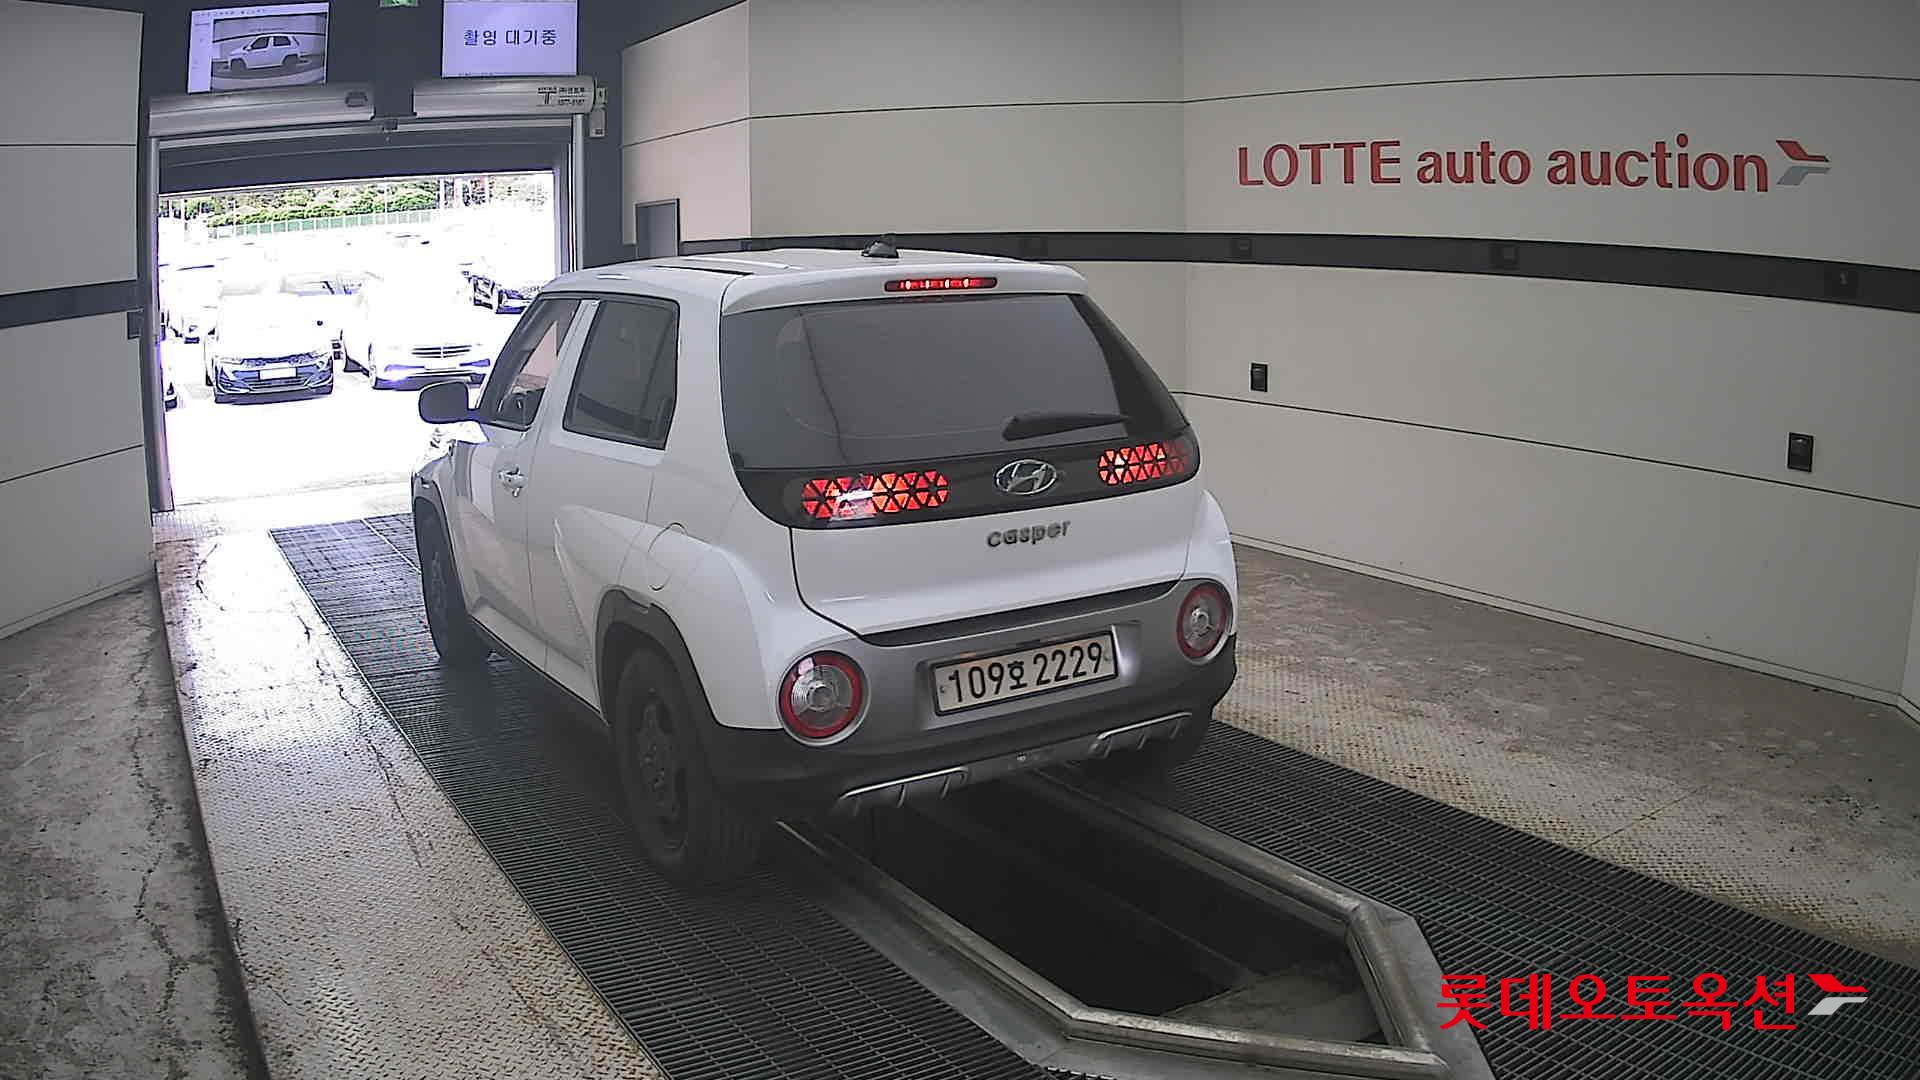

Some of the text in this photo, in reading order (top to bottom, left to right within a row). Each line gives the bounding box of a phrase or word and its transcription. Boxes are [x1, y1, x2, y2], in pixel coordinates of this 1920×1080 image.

[505, 28, 557, 46] 대기중
[1238, 132, 1769, 193] LOTTE auto auction
[987, 520, 1071, 548] casper
[948, 642, 1103, 703] 109호 2229
